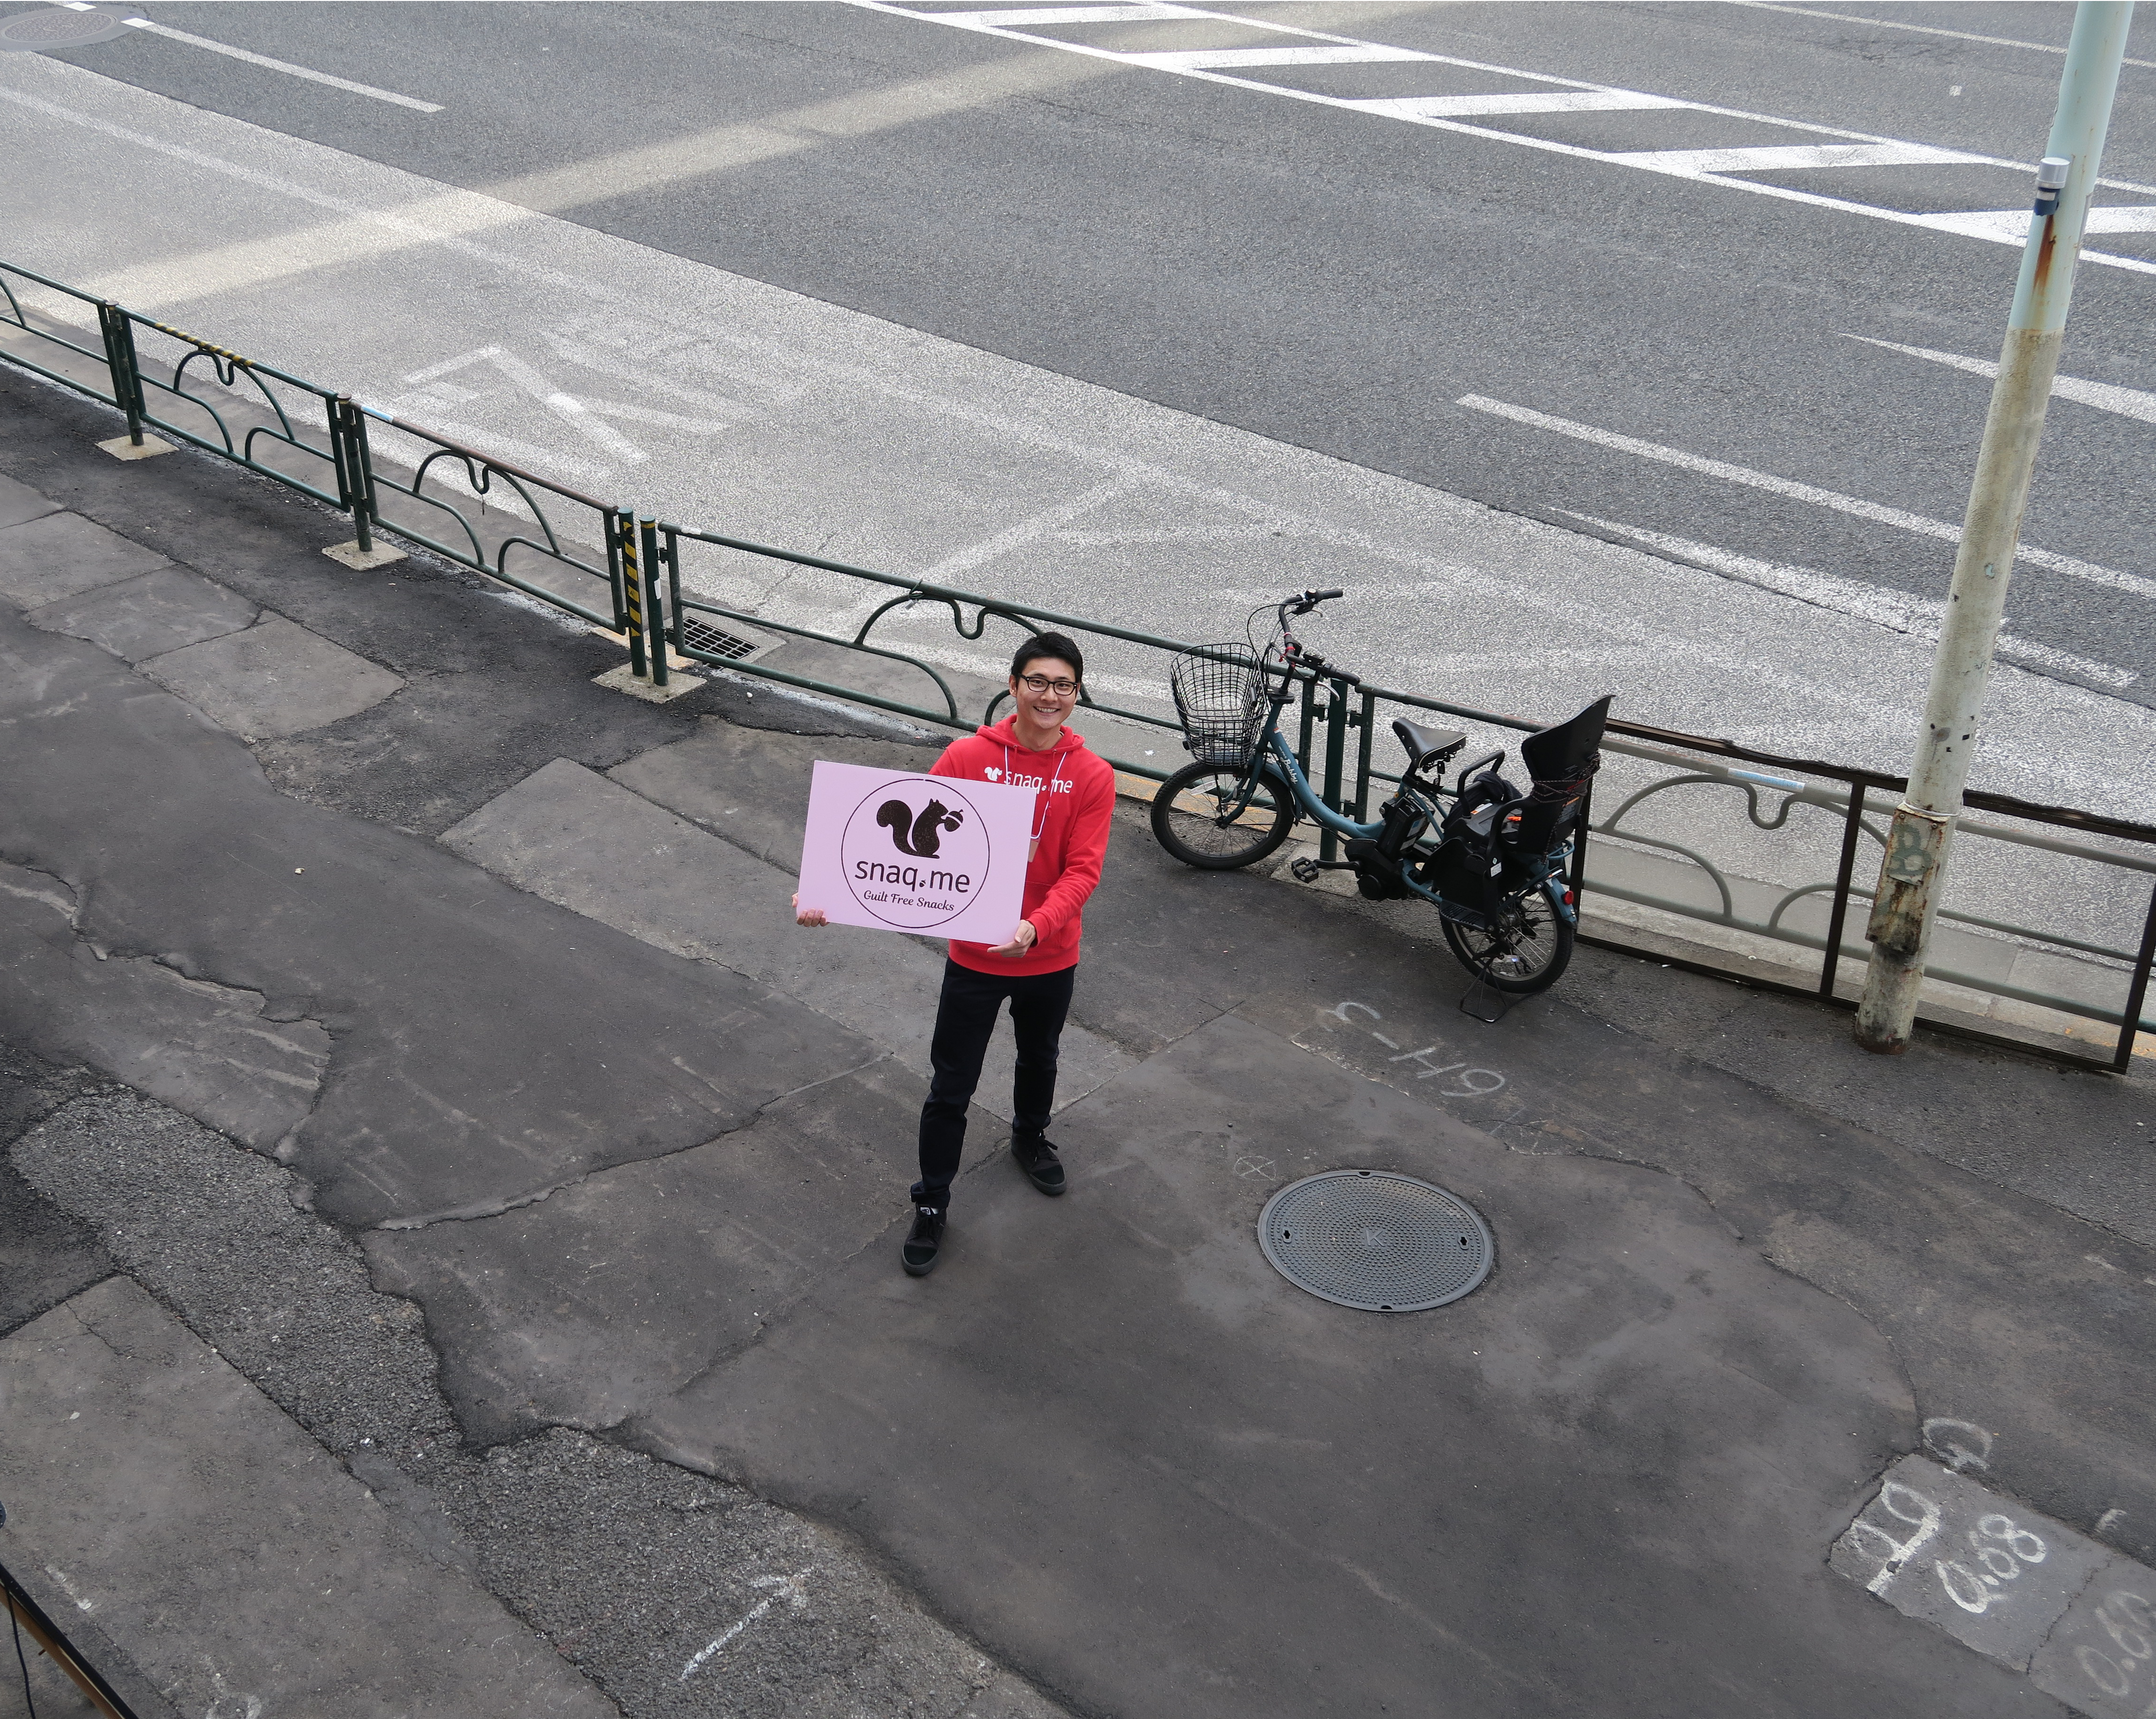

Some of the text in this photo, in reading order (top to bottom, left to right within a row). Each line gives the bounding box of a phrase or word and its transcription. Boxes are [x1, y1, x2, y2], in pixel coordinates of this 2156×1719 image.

[1280, 756, 1298, 784] Babby
[854, 861, 970, 893] snaq.me
[863, 890, 955, 912] Guilt Free Snacks
[1365, 1229, 1385, 1247] K
